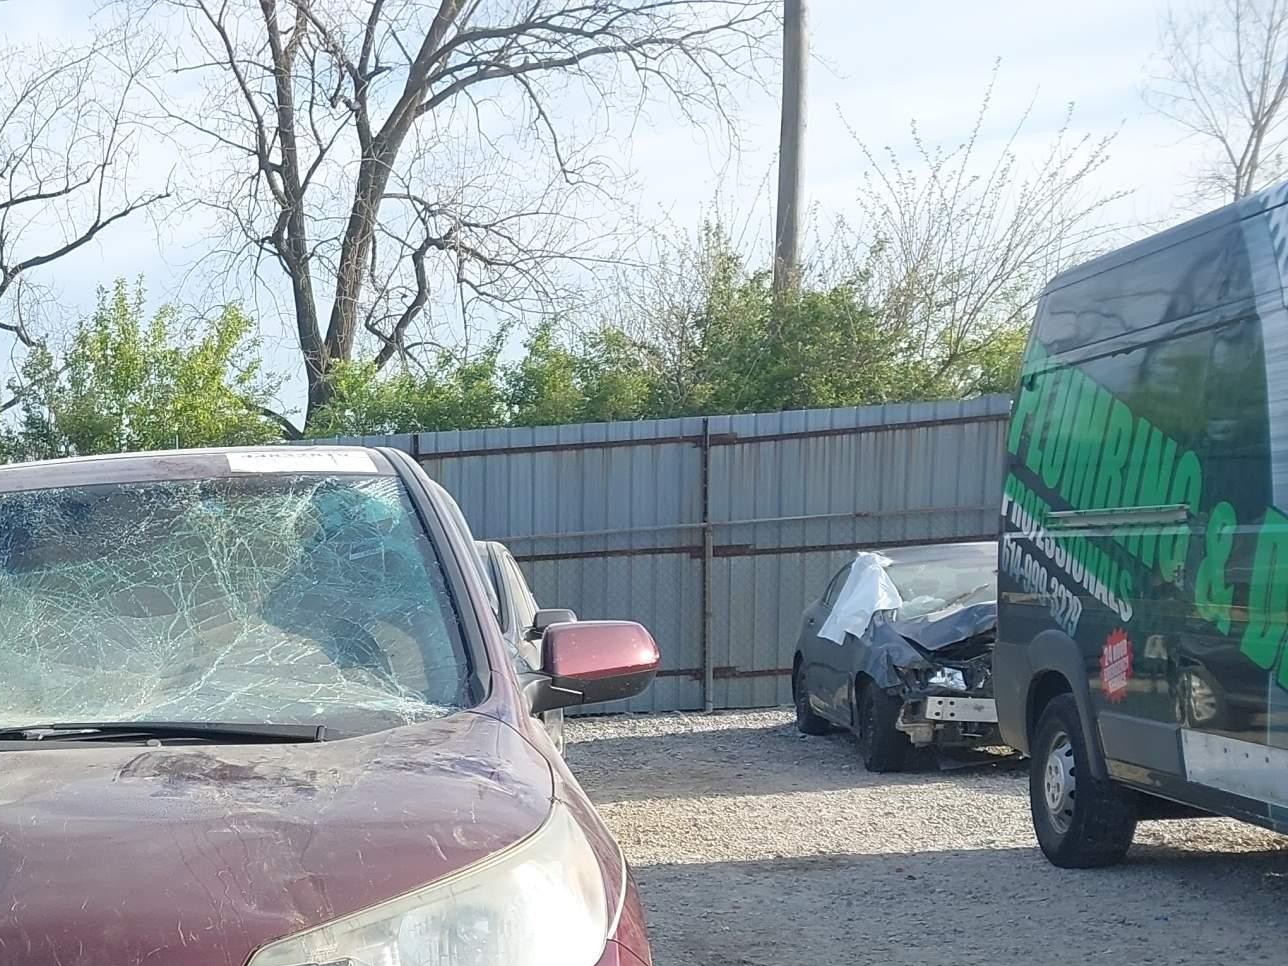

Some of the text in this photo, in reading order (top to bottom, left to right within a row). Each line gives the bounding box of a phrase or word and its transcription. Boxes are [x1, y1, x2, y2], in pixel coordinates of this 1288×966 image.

[1001, 472, 1133, 622] PROFESSIONALS
[1008, 338, 1201, 583] PLUMBING
[1195, 500, 1238, 636] &
